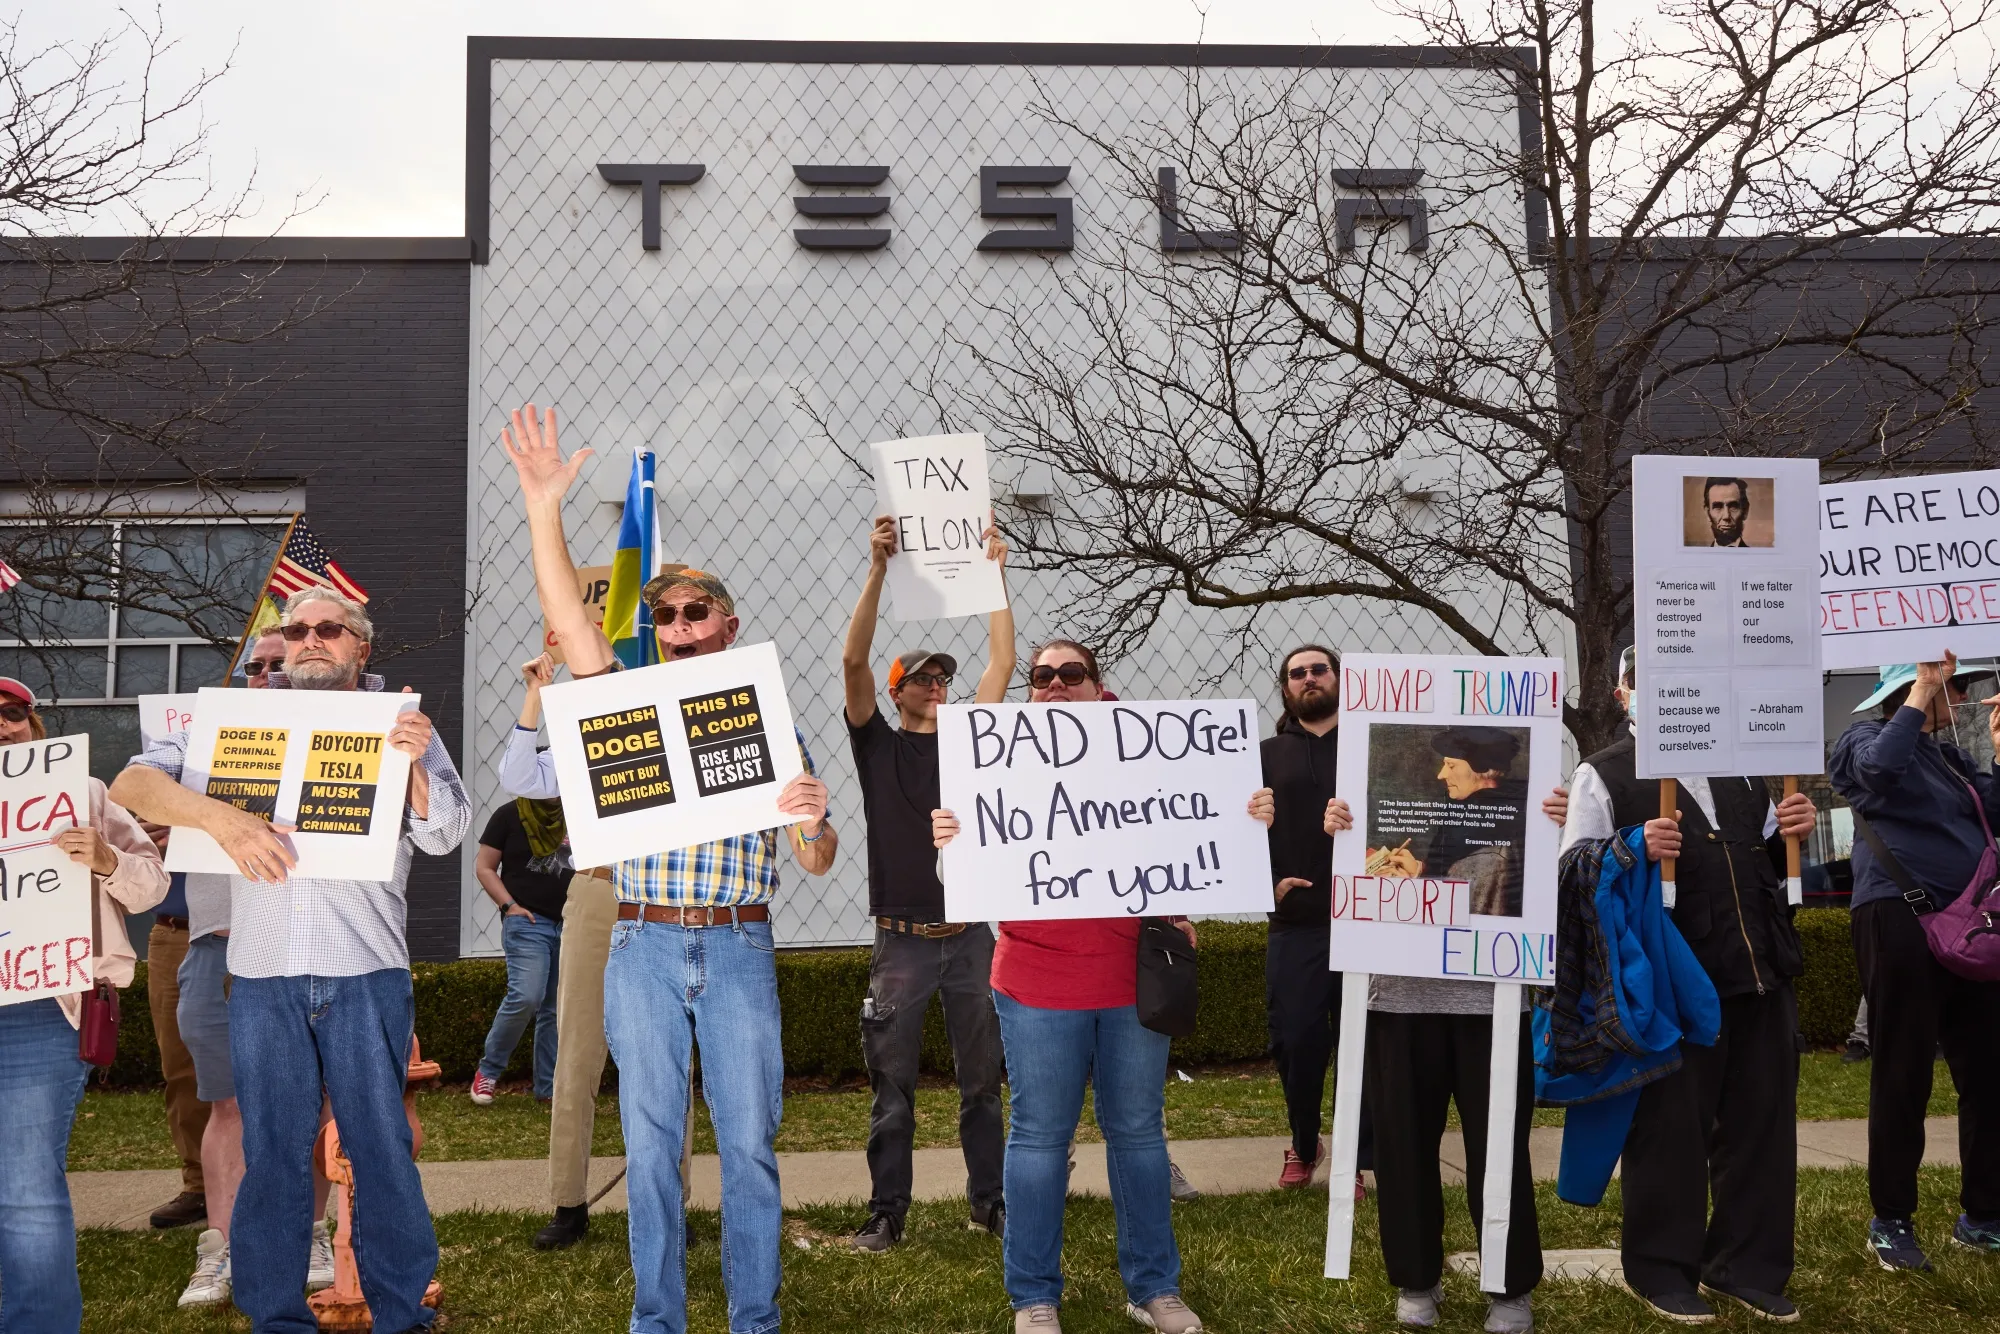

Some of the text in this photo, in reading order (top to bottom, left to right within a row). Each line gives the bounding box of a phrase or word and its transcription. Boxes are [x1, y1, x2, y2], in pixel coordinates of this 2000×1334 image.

[596, 164, 1428, 252] TESLA
[893, 456, 969, 492] TAX
[1819, 485, 2000, 530] E ARE LO
[899, 515, 984, 552] ELON
[1894, 539, 2000, 573] DEMOC
[1655, 581, 1716, 591] “America will
[1741, 581, 1793, 591] If we falter
[1656, 597, 1695, 606] never be
[1742, 598, 1785, 608] and lose
[1952, 584, 2000, 620] RE
[1656, 613, 1702, 624] destroyed
[1742, 618, 1760, 626] our
[1657, 629, 1696, 638] from the
[1742, 634, 1794, 645] freedoms,
[1657, 644, 1694, 653] outside.
[1345, 667, 1558, 716] DUMP TRUMP!
[1658, 687, 1701, 698] it will be
[683, 692, 750, 717] THIS IS
[1658, 705, 1720, 715] because we
[581, 708, 656, 733] ABOLISH
[690, 713, 758, 738] A COUP
[1659, 722, 1711, 734] destroyed
[1749, 721, 1786, 731] Lincoln
[220, 730, 286, 742] DOGE IS A
[311, 734, 382, 753] BOYCOTT
[967, 708, 1088, 769] BAD
[223, 746, 277, 756] CRIMINAL
[586, 730, 661, 760] DOGE
[1659, 739, 1716, 751] ourselves.”
[2, 742, 73, 778] UP
[698, 743, 760, 768] RISE AND
[213, 760, 282, 771] ENTERPRISE
[320, 761, 363, 779] TESLA
[702, 758, 763, 788] RESIST
[601, 764, 661, 788] DON’T BUY
[208, 781, 279, 797] OVERTHROW
[311, 785, 361, 799] MUSK
[599, 780, 671, 806] SWASTICARS
[231, 798, 248, 809] THE
[300, 804, 371, 817] IS A CYBER
[1498, 805, 1518, 813] pride,
[2, 791, 78, 838] ICA
[976, 781, 1219, 847] No America
[1379, 808, 1400, 816] vanity
[302, 820, 363, 833] CRIMINAL
[1378, 817, 1397, 825] fools,
[1398, 818, 1429, 826] however,
[1025, 841, 1223, 914] for you!!
[1332, 875, 1470, 925] DEPORT
[1442, 928, 1556, 979] ELON!
